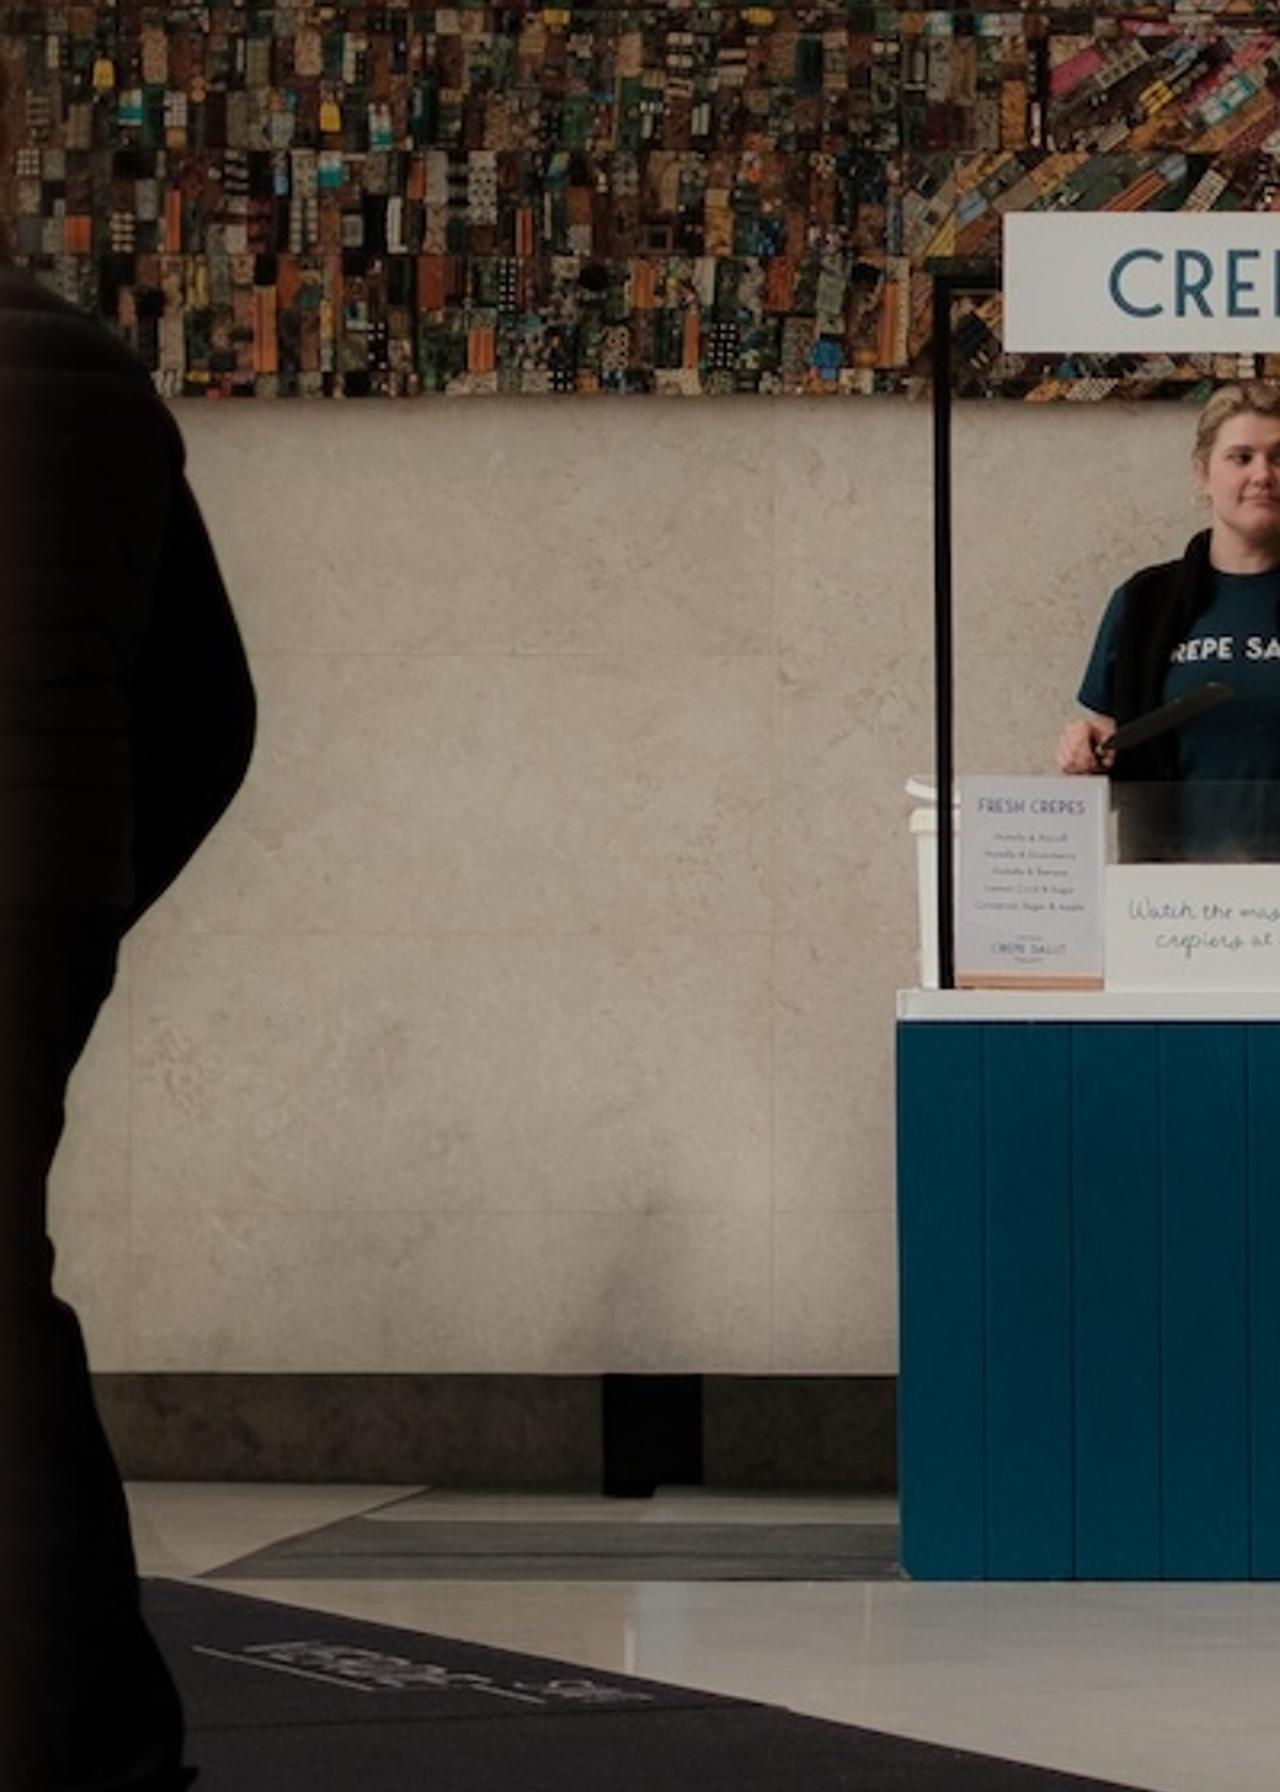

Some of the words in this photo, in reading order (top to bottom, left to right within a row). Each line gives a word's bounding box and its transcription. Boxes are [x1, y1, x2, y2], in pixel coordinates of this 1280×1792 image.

[977, 797, 1025, 814] FRESH
[1030, 799, 1086, 816] CREPES
[1129, 896, 1199, 921] Watch
[1202, 903, 1233, 921] the
[1250, 931, 1273, 948] at
